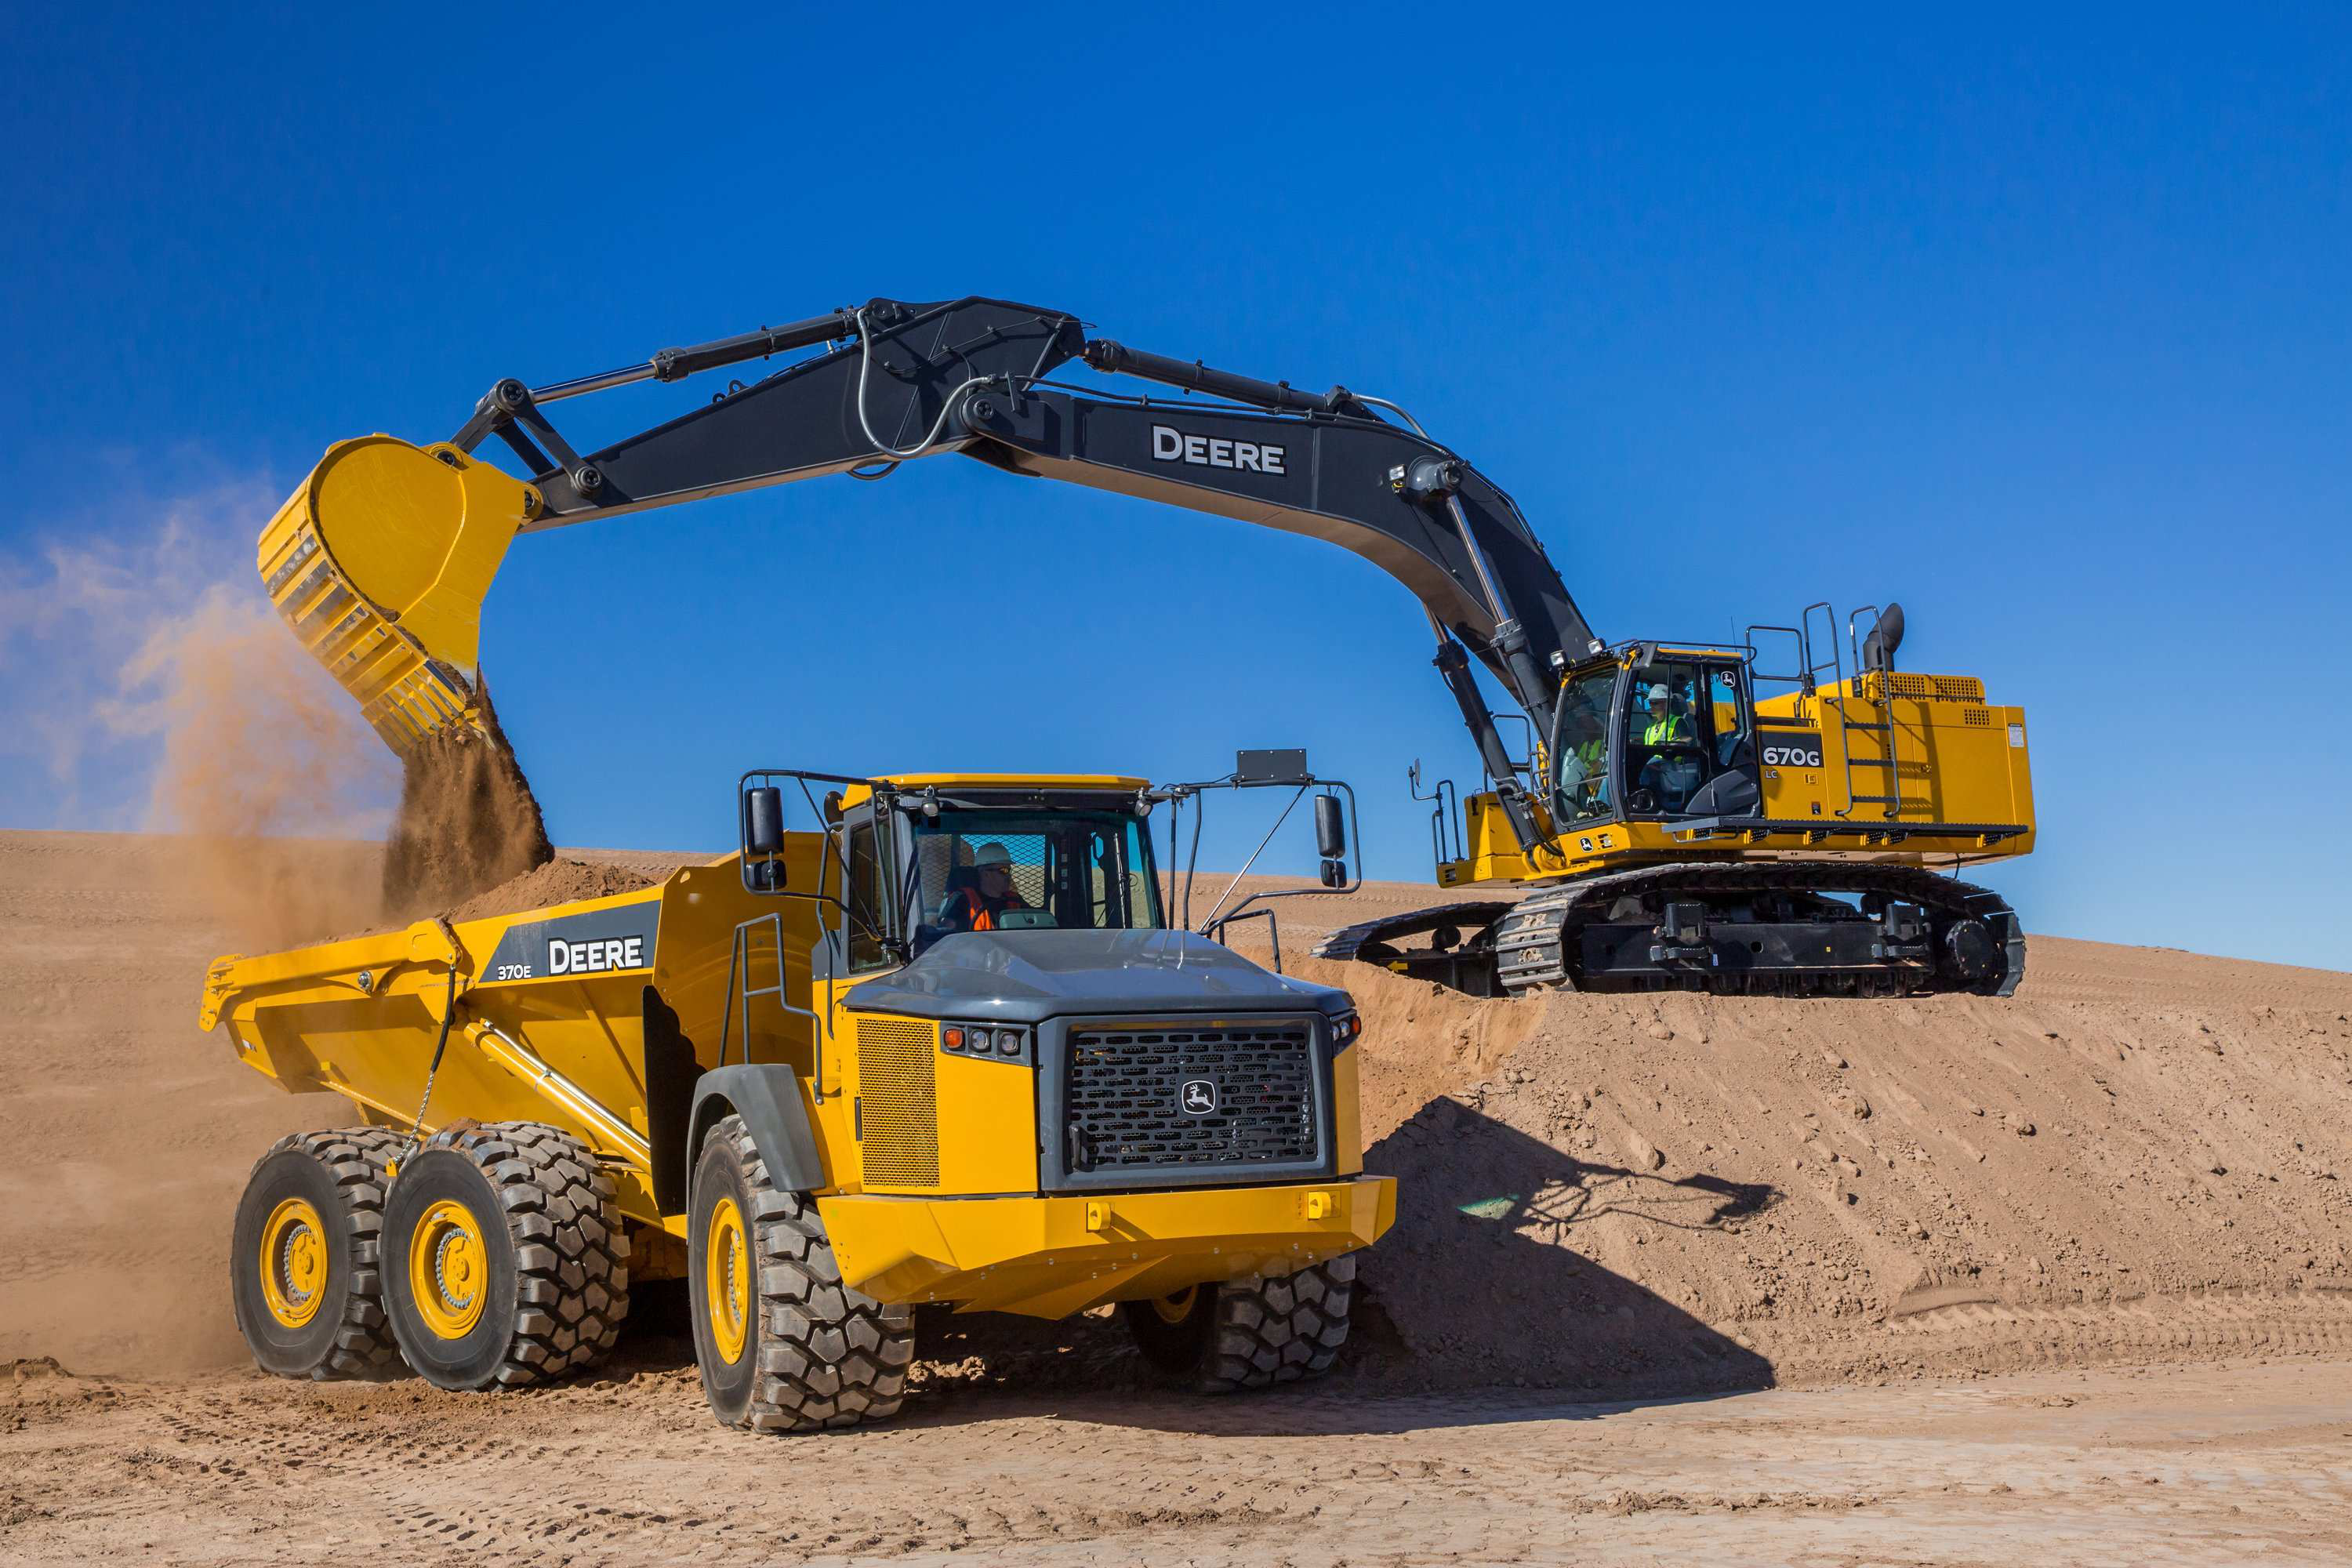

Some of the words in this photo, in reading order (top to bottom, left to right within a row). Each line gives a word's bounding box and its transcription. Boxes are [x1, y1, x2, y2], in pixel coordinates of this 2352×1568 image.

[1152, 425, 1284, 474] DEERE
[1764, 746, 1820, 767] 670G
[549, 938, 643, 975] DEERE
[498, 964, 532, 980] 370E
